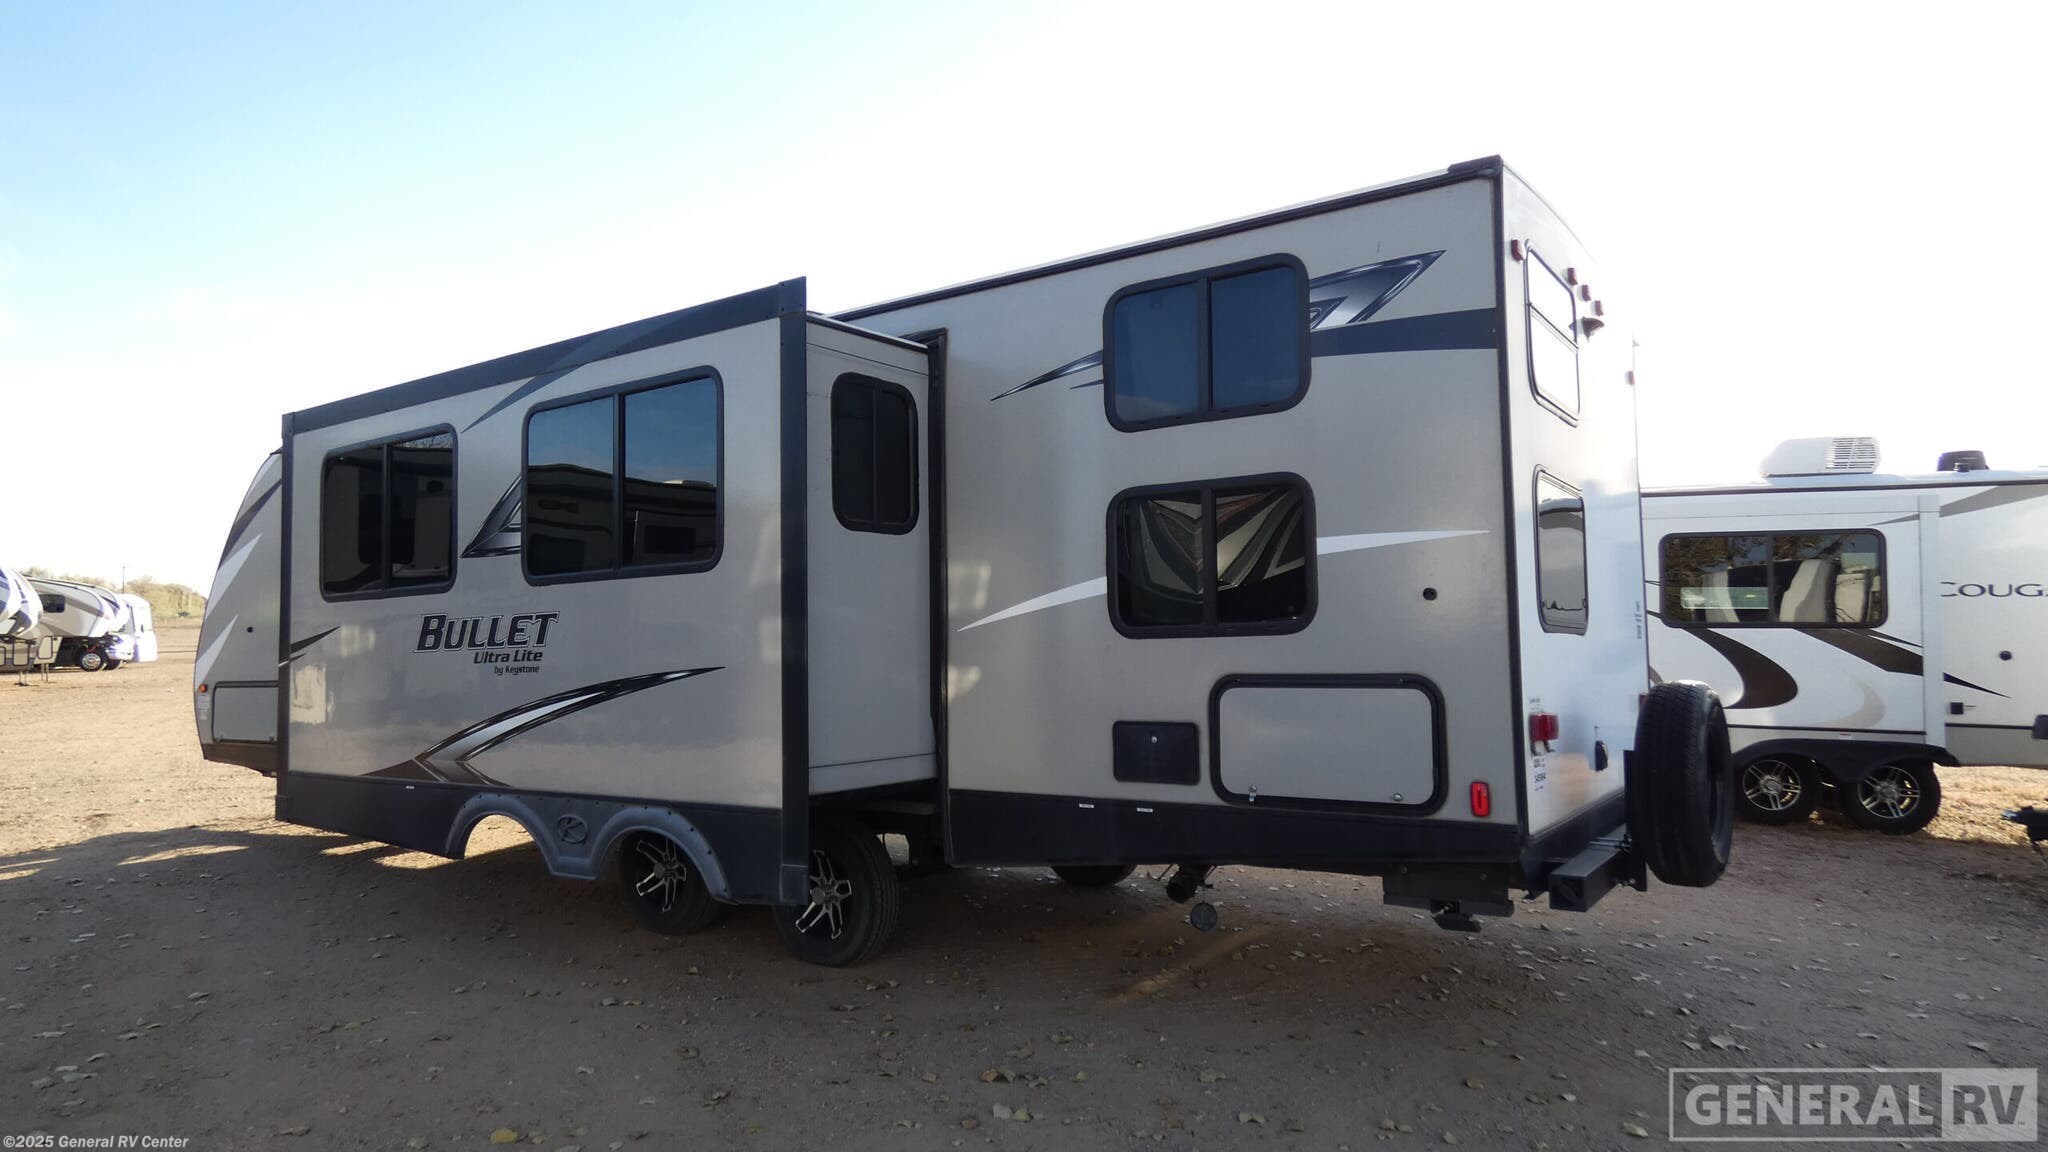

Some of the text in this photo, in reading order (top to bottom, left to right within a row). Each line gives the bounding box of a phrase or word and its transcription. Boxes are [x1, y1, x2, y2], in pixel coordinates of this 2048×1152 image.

[1940, 582, 2048, 597] COUG
[413, 611, 560, 653] BULLET
[474, 650, 543, 664] Ultra Lite
[494, 665, 540, 676] by Keystone
